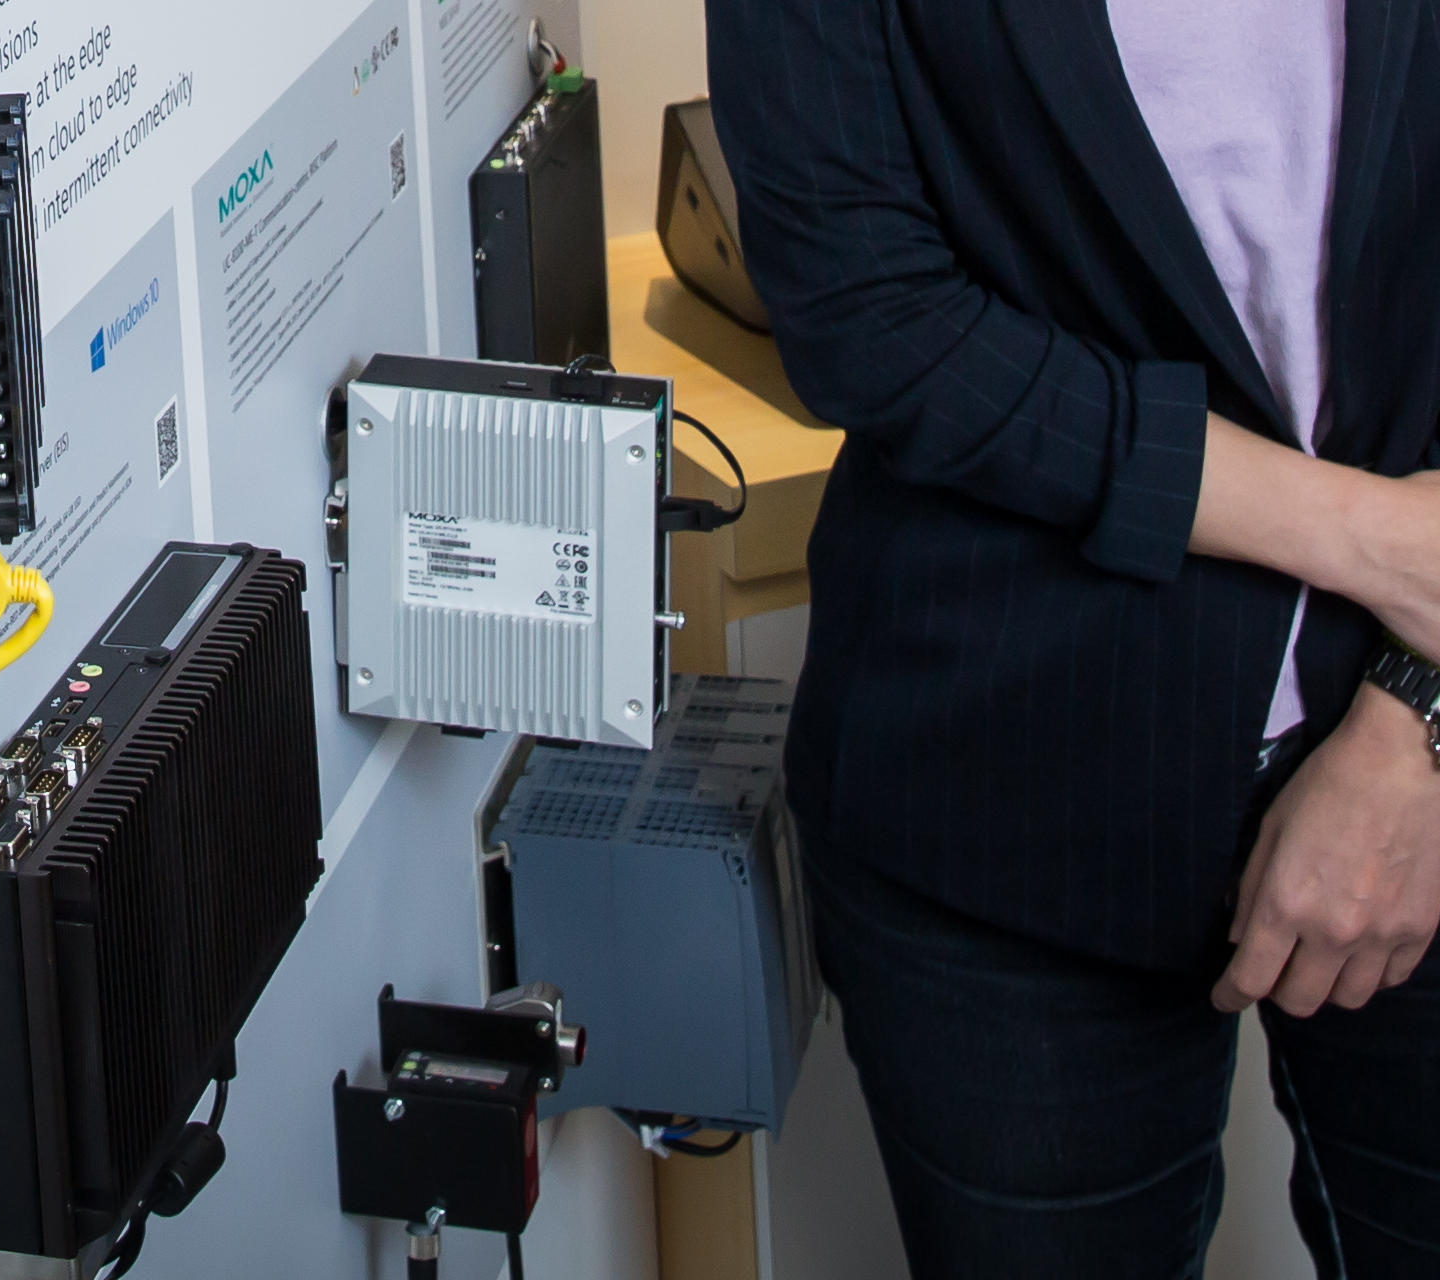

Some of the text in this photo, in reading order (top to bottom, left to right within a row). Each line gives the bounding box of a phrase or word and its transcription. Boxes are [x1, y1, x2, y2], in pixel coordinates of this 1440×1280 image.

[36, 24, 111, 108] at the edge
[42, 70, 194, 233] intermittent connectivity
[48, 63, 138, 161] cloud to edge
[218, 149, 274, 224] MOXA
[107, 277, 159, 350] Windows 10
[408, 512, 458, 524] MOXA
